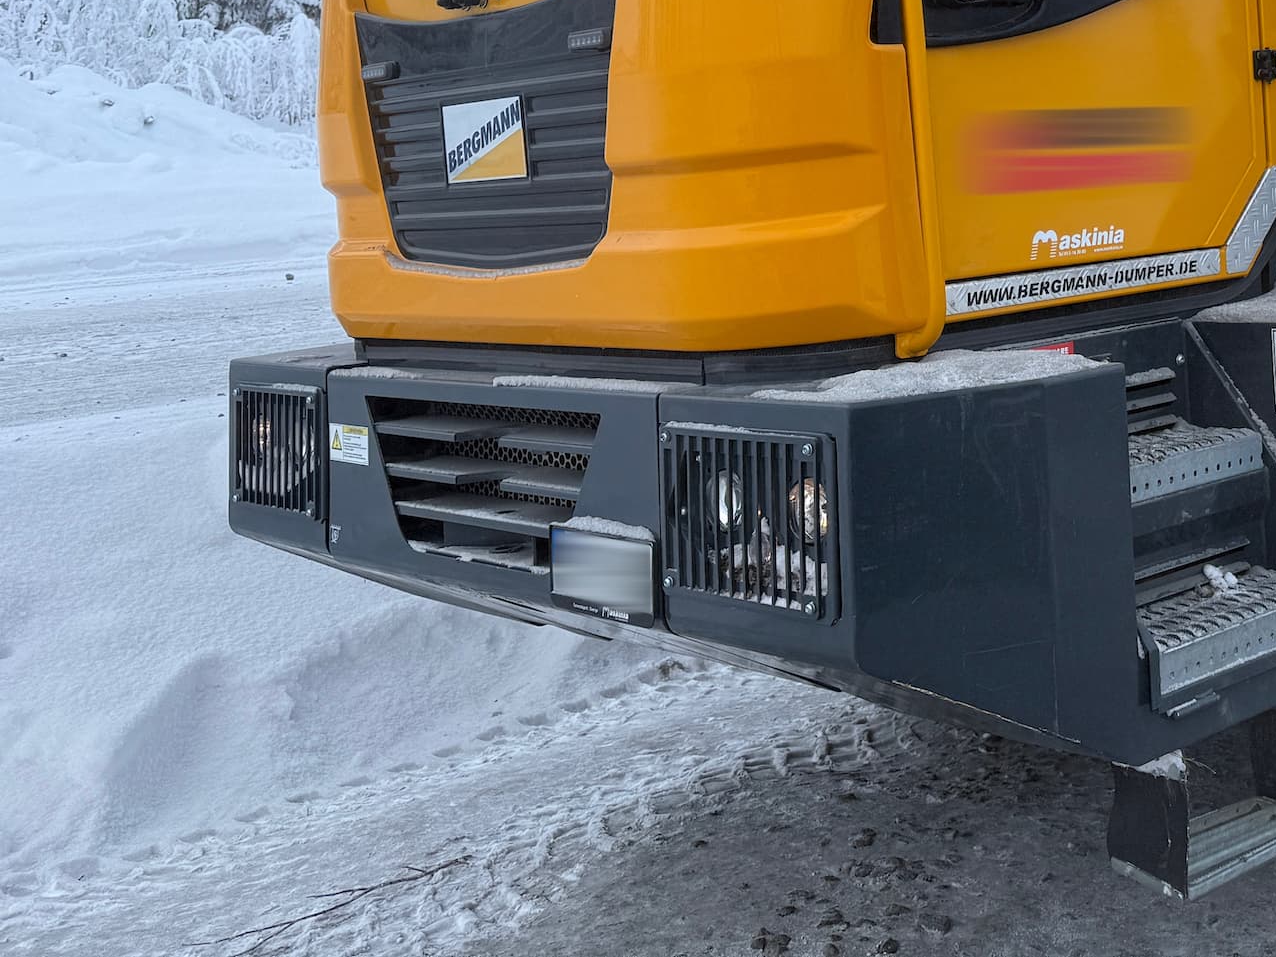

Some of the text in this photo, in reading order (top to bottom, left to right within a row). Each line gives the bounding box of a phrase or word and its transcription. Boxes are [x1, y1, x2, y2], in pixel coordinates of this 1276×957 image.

[448, 99, 521, 173] BERGMANN
[1030, 225, 1125, 260] Maskinia
[966, 259, 1198, 307] WWW.BERGMANN-DUMPER.DE
